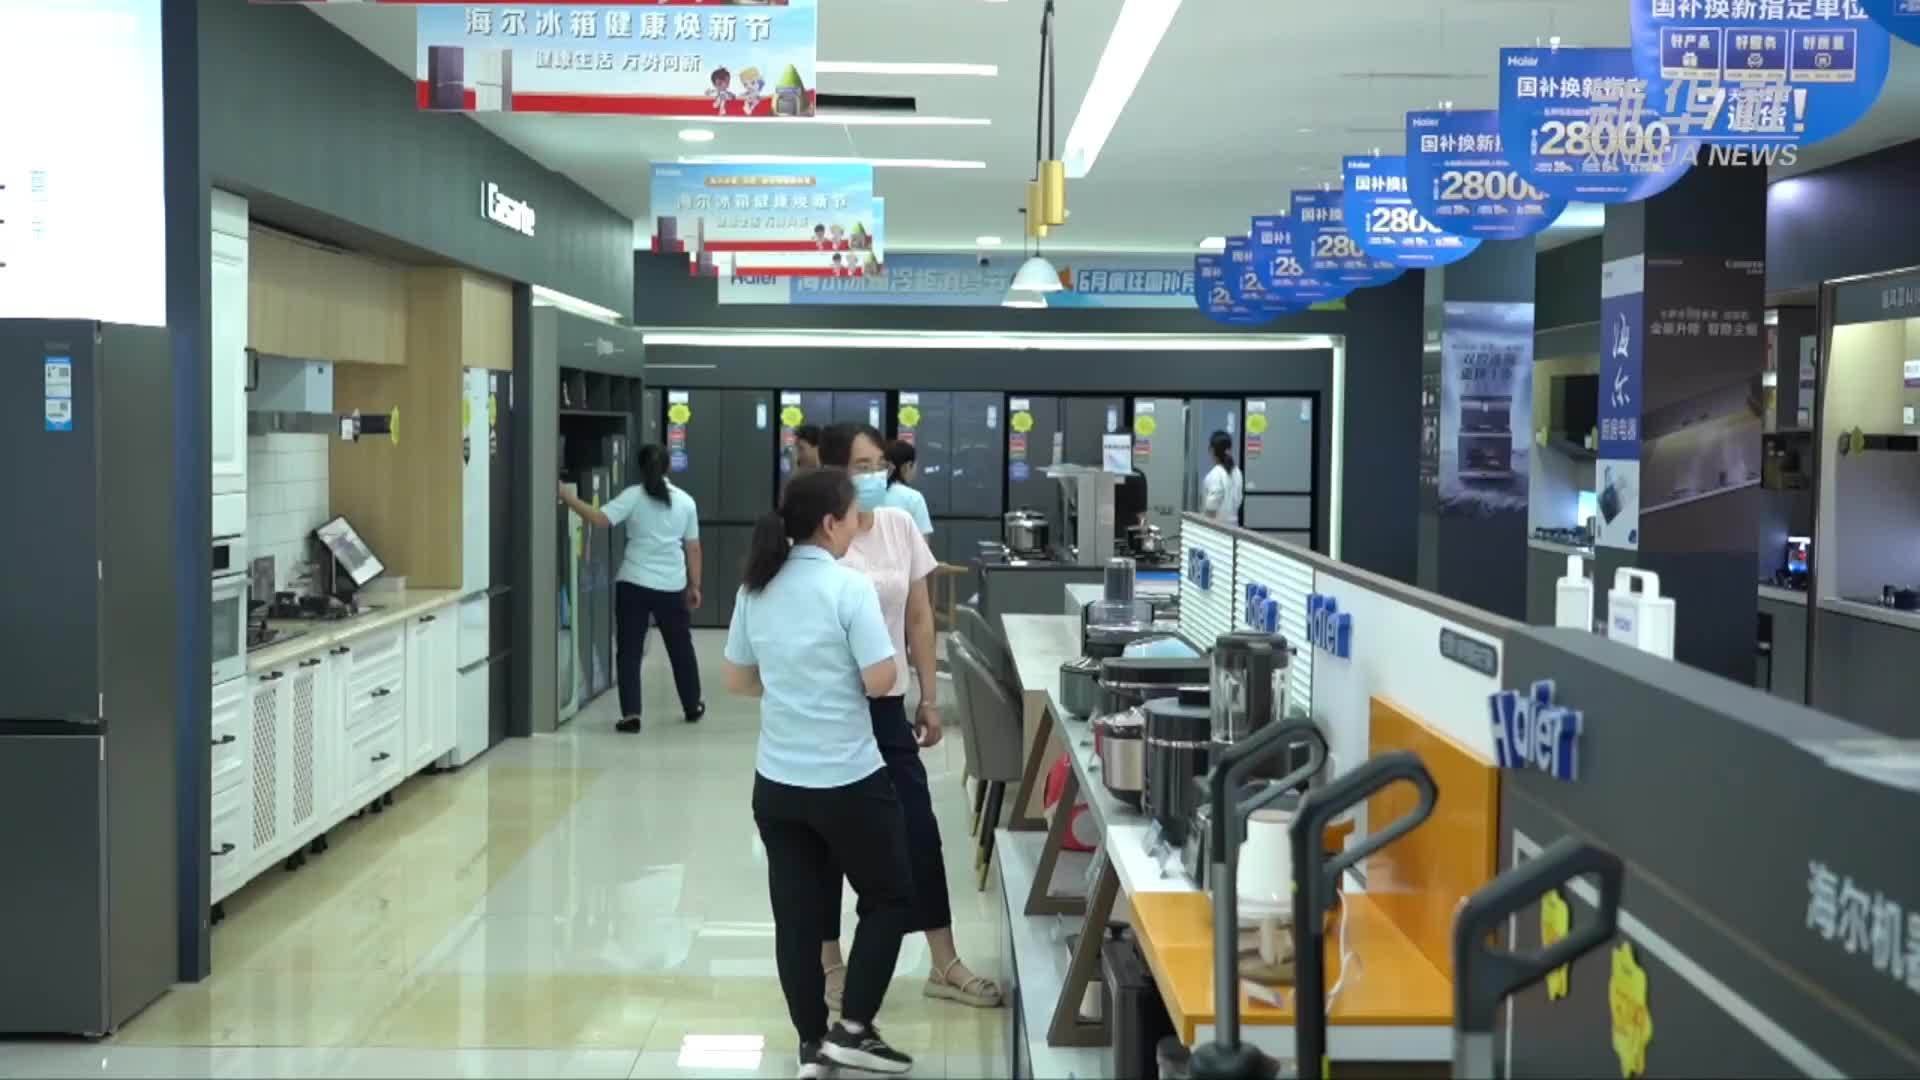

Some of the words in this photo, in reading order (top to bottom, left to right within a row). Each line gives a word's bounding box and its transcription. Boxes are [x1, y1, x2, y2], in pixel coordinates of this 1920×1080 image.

[1651, 0, 1868, 20] 国补换新指定单位
[464, 7, 773, 42] 海尔冰箱健康焕新节
[1507, 56, 1539, 67] Haier
[1412, 118, 1440, 128] Haier
[1539, 120, 1671, 156] 28000
[1355, 175, 1408, 192] 国补换
[1488, 678, 1584, 784] Haier
